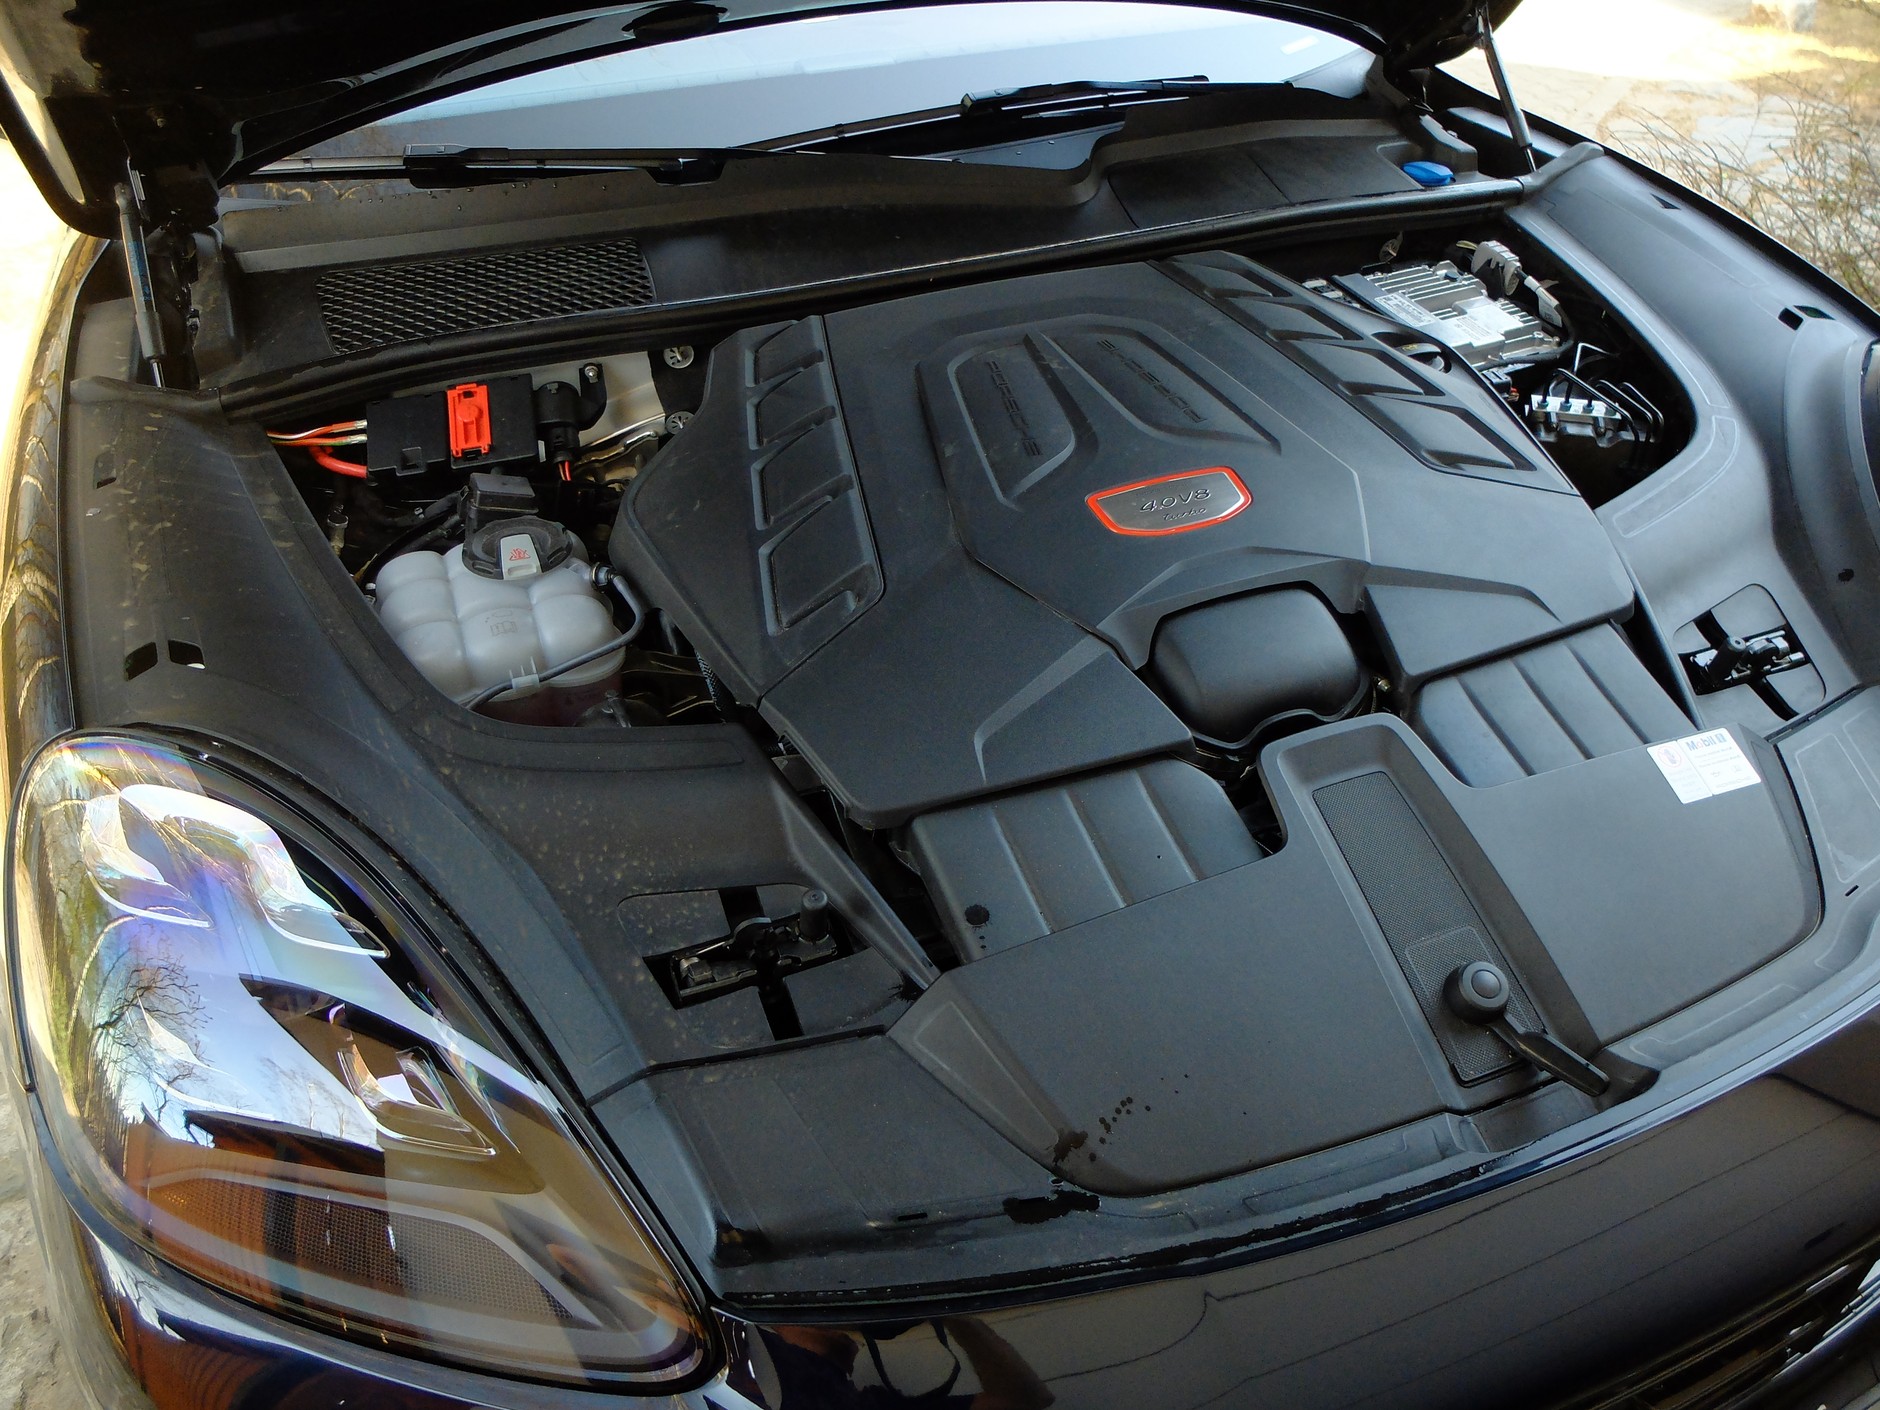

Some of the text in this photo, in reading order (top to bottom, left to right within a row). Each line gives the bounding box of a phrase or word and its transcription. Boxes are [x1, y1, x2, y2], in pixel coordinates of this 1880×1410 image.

[985, 360, 1042, 457] PORSCHE
[1096, 338, 1208, 424] PORSCHE
[1685, 737, 1715, 751] Mobil
